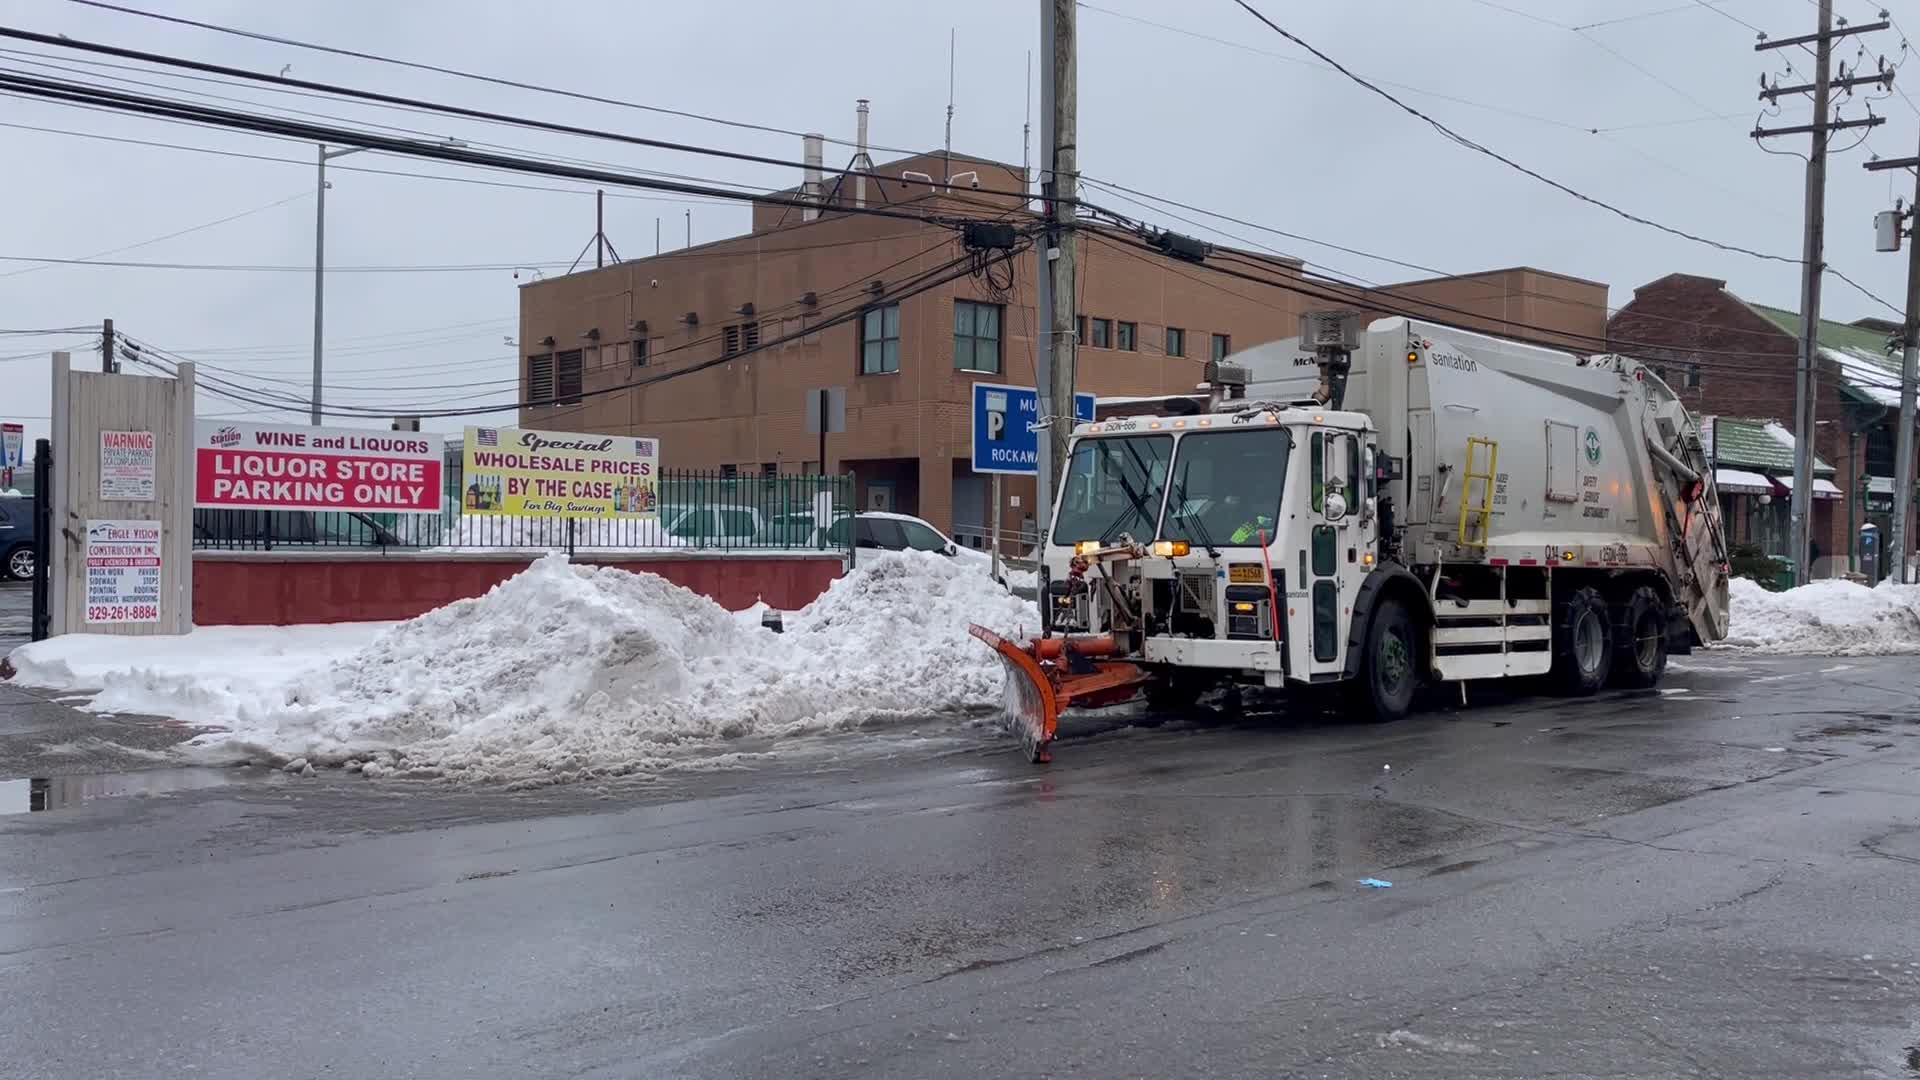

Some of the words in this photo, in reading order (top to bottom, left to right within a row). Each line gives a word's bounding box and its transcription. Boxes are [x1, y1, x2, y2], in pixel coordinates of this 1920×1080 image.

[1431, 351, 1478, 372] sanitation
[988, 411, 1004, 440] P
[103, 433, 153, 449] WARNING
[255, 431, 306, 448] WINE
[311, 436, 345, 449] and
[350, 437, 429, 454] LIQUORS
[518, 433, 613, 452] Special
[215, 454, 327, 478] LIQUOR
[336, 460, 425, 483] STORE
[474, 452, 585, 473] WHOLESALE
[591, 460, 651, 476] PRICES
[213, 478, 345, 503] PARKING
[353, 484, 425, 505] ONLY
[508, 478, 530, 496] BY
[535, 479, 567, 498] THE
[572, 481, 613, 500] CASE
[522, 499, 542, 511] For
[544, 500, 563, 514] Big
[566, 501, 606, 514] Savings
[107, 528, 129, 540] EAGLE
[133, 528, 159, 540] VISION
[89, 545, 141, 556] CONSTRUCTION
[89, 568, 106, 576] BRICK
[107, 568, 125, 576] WORK
[138, 568, 159, 576] PAVERS
[89, 577, 117, 585] SIDEWALK
[143, 577, 159, 585] STEPS
[89, 586, 117, 594] POINTING
[134, 586, 158, 594] ROOFING
[89, 595, 119, 604] DRIVEWAYS
[88, 605, 158, 620] 929-261-8884
